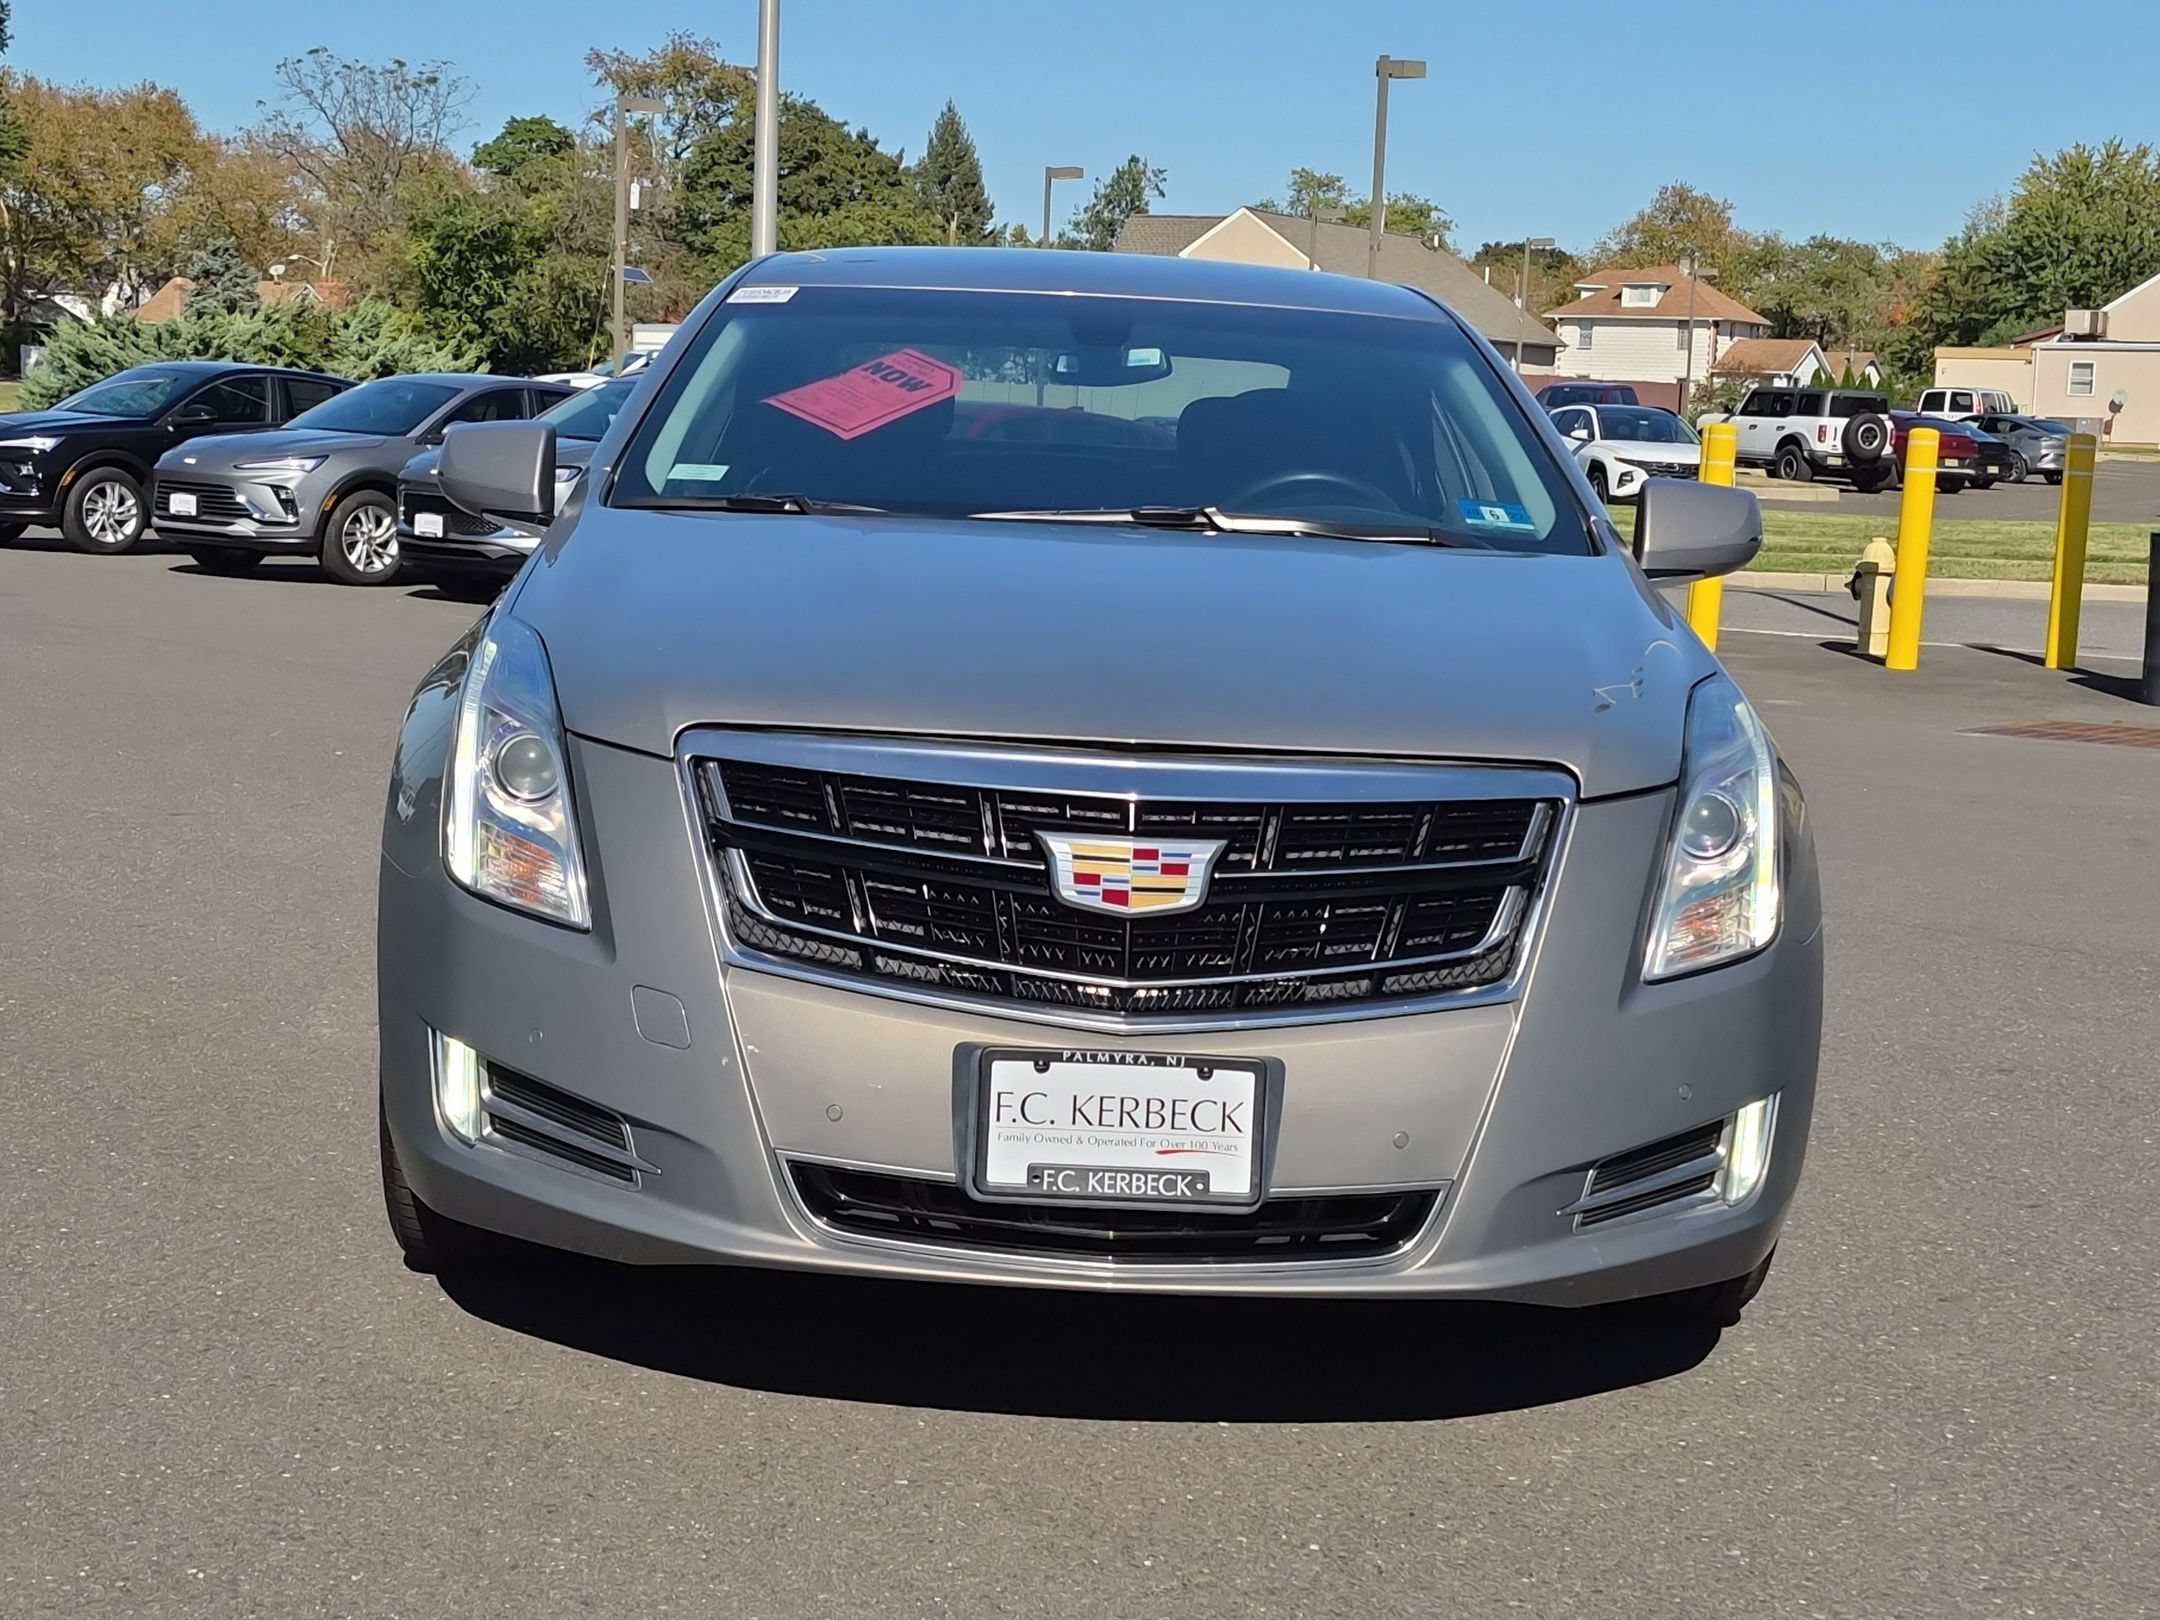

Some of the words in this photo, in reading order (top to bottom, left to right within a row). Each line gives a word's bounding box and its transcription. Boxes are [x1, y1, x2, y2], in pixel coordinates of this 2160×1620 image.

[860, 361, 934, 393] NOW
[1488, 510, 1500, 520] 6
[1062, 1050, 1155, 1066] PALMYRA,
[1166, 1056, 1185, 1068] NJ
[996, 1091, 1055, 1125] F.C.
[1071, 1094, 1244, 1133] KERBECK
[997, 1132, 1031, 1145] Family
[1034, 1134, 1073, 1145] Owned
[1076, 1136, 1084, 1144] &
[1087, 1135, 1137, 1148] Operated
[1140, 1137, 1156, 1148] For
[1160, 1138, 1186, 1149] Over
[1190, 1140, 1208, 1150] 100
[1212, 1141, 1238, 1152] Years
[1042, 1170, 1080, 1192] F.C.
[1087, 1172, 1192, 1196] KERBECK
